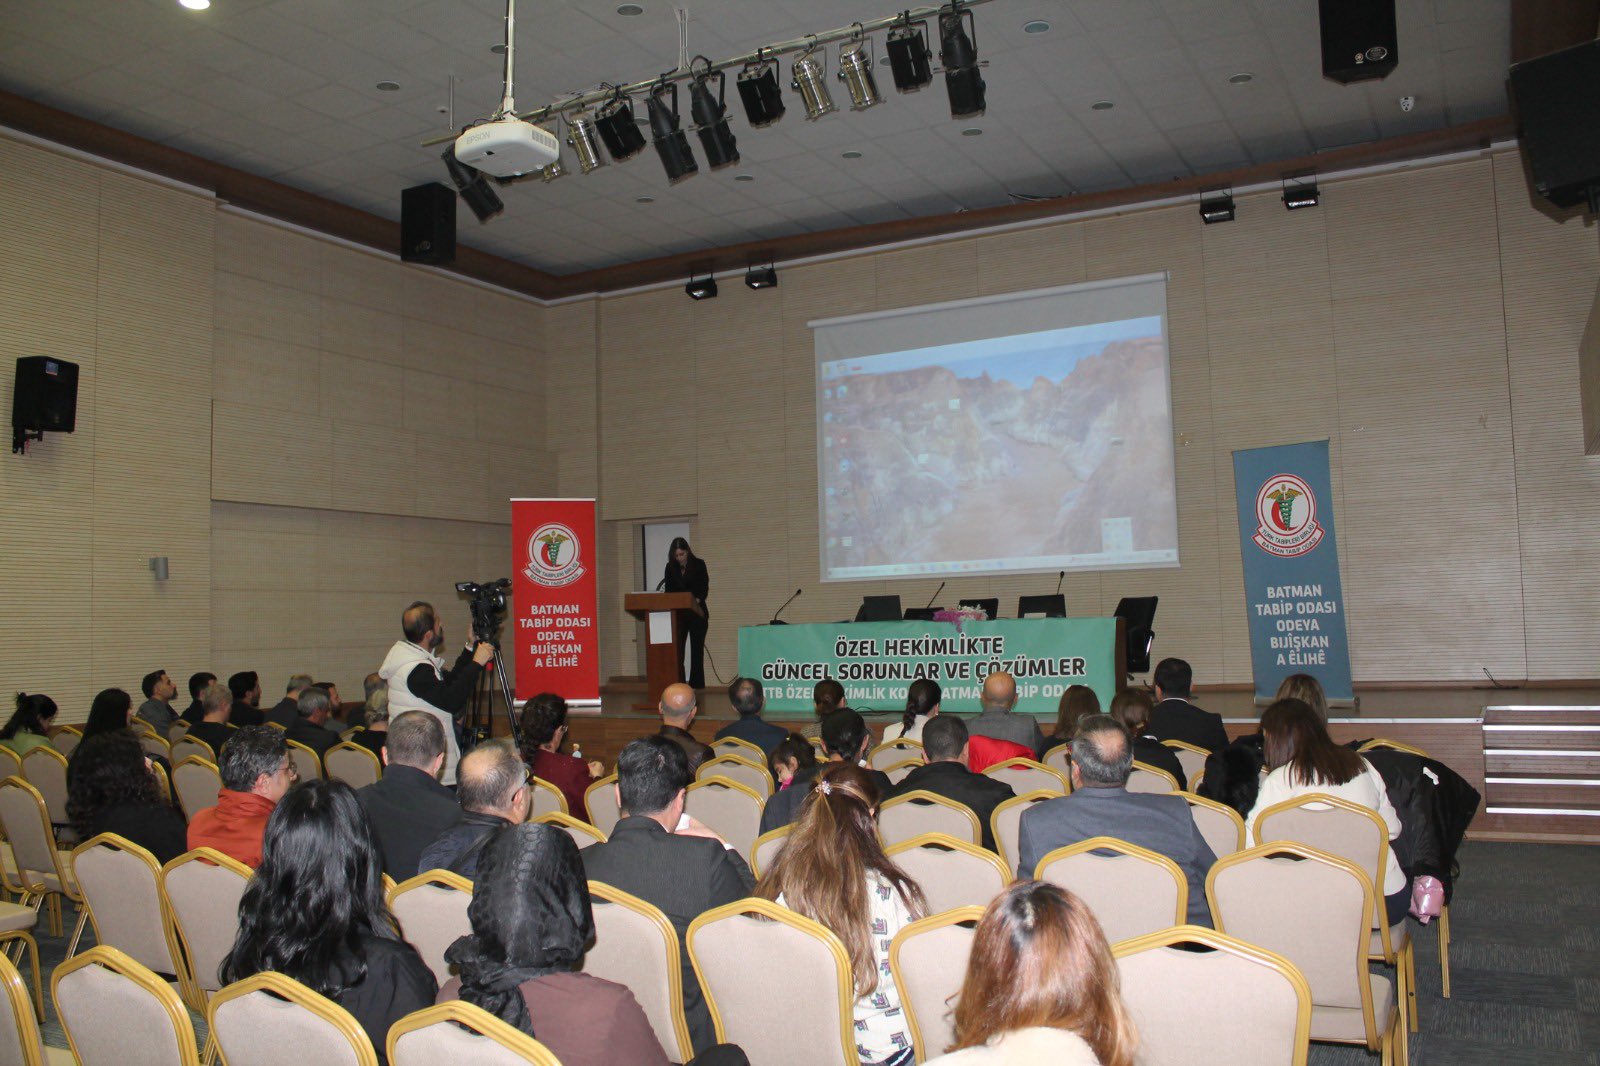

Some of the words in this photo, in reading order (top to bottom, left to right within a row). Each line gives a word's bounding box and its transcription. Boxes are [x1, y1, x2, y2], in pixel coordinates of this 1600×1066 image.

[466, 130, 491, 145] EPSON
[1261, 541, 1285, 554] BATMAN
[1266, 584, 1322, 599] BATMAN
[531, 604, 580, 615] BATMAN
[1255, 600, 1293, 616] TABİP
[1296, 601, 1337, 614] ODASI
[520, 615, 553, 628] TABİP
[555, 617, 591, 628] ODASI
[1276, 618, 1320, 632] ODEYA
[536, 630, 575, 641] ODEYA
[1270, 632, 1329, 652] BIJÎŞKAN
[530, 642, 582, 657] BIJÎŞKAN
[835, 635, 879, 657] ÖZEL
[884, 633, 1003, 657] HEKİMLİKTE
[535, 658, 543, 668] A
[545, 654, 579, 668] ÊLIHÊ
[1276, 653, 1286, 666] A
[1288, 649, 1326, 666] ÊLIHÊ
[762, 658, 833, 681] GÜNCEL
[838, 661, 940, 681] SORUNLAR
[944, 661, 970, 680] VE
[975, 655, 1086, 684] ÇÖZÜMLER
